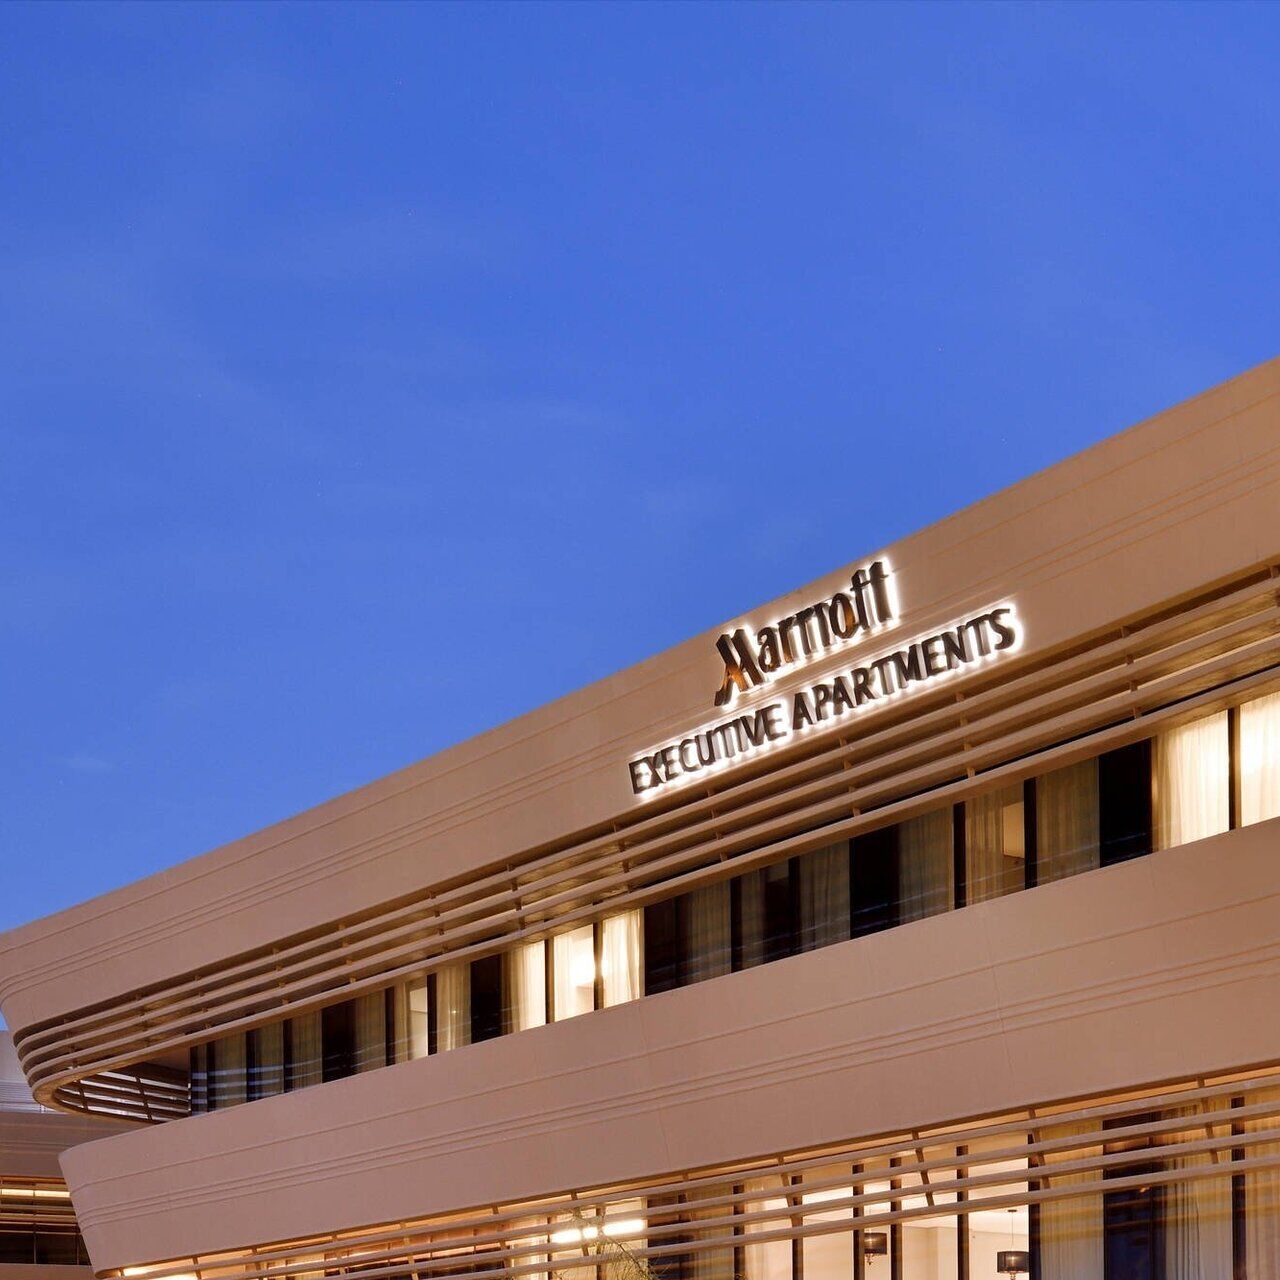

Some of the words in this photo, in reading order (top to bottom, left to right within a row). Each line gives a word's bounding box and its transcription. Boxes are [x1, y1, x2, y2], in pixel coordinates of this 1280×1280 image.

[628, 703, 787, 795] EXECUTIVE
[792, 608, 1017, 730] APARTMENTS
[714, 560, 892, 707] Marriott
